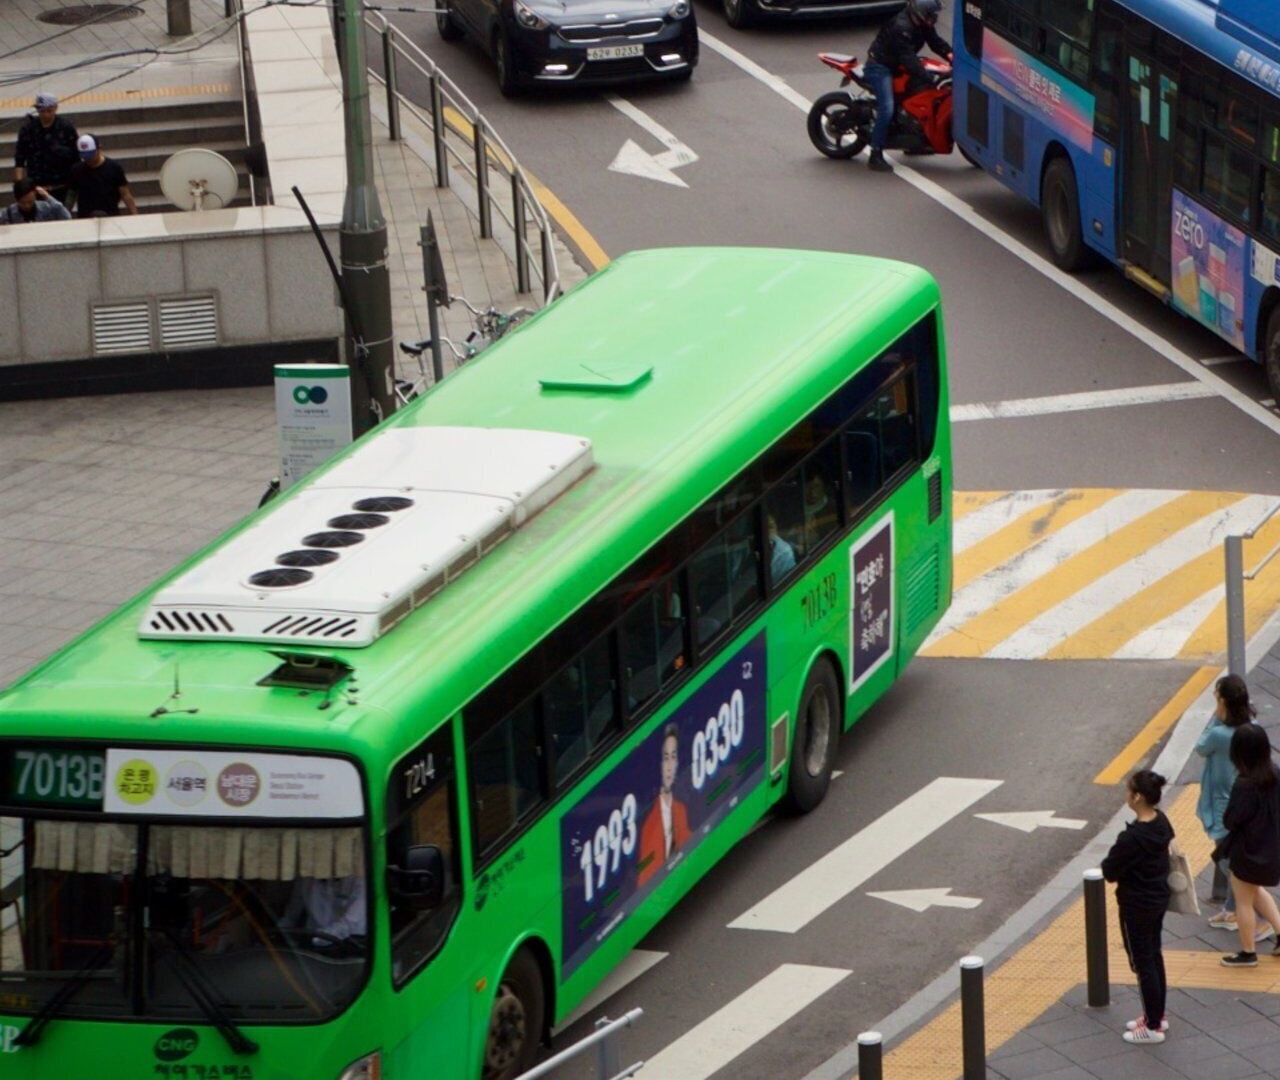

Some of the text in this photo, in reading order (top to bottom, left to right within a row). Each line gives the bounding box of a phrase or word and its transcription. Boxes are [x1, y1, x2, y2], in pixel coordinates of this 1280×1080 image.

[1175, 210, 1205, 249] zero
[692, 688, 745, 791] 0330
[15, 751, 106, 799] 7013B
[167, 777, 207, 791] 서울역
[579, 794, 638, 902] 1993
[158, 1037, 195, 1053] CNG
